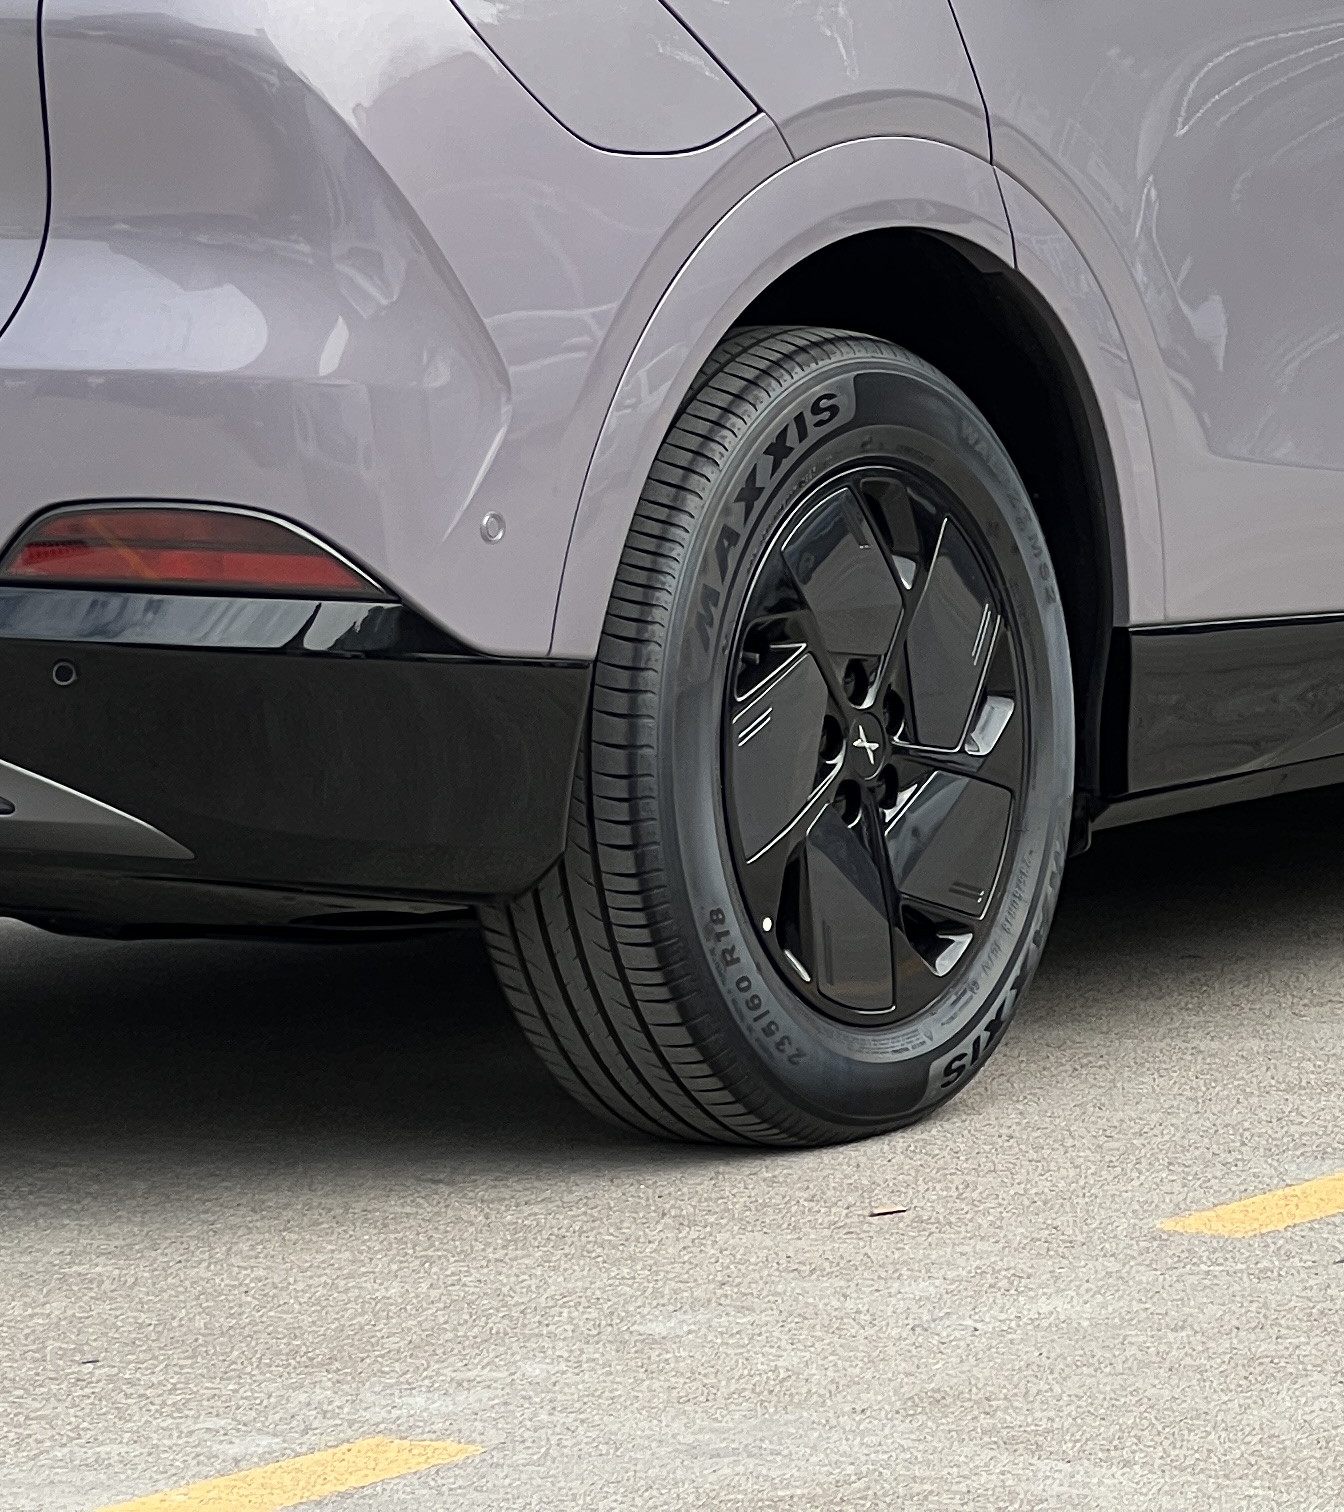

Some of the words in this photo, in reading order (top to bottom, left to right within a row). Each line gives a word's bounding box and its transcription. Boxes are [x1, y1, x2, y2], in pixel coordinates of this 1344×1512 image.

[694, 392, 841, 654] MAXXIS
[709, 907, 742, 969] R18
[734, 974, 807, 1067] 235/60
